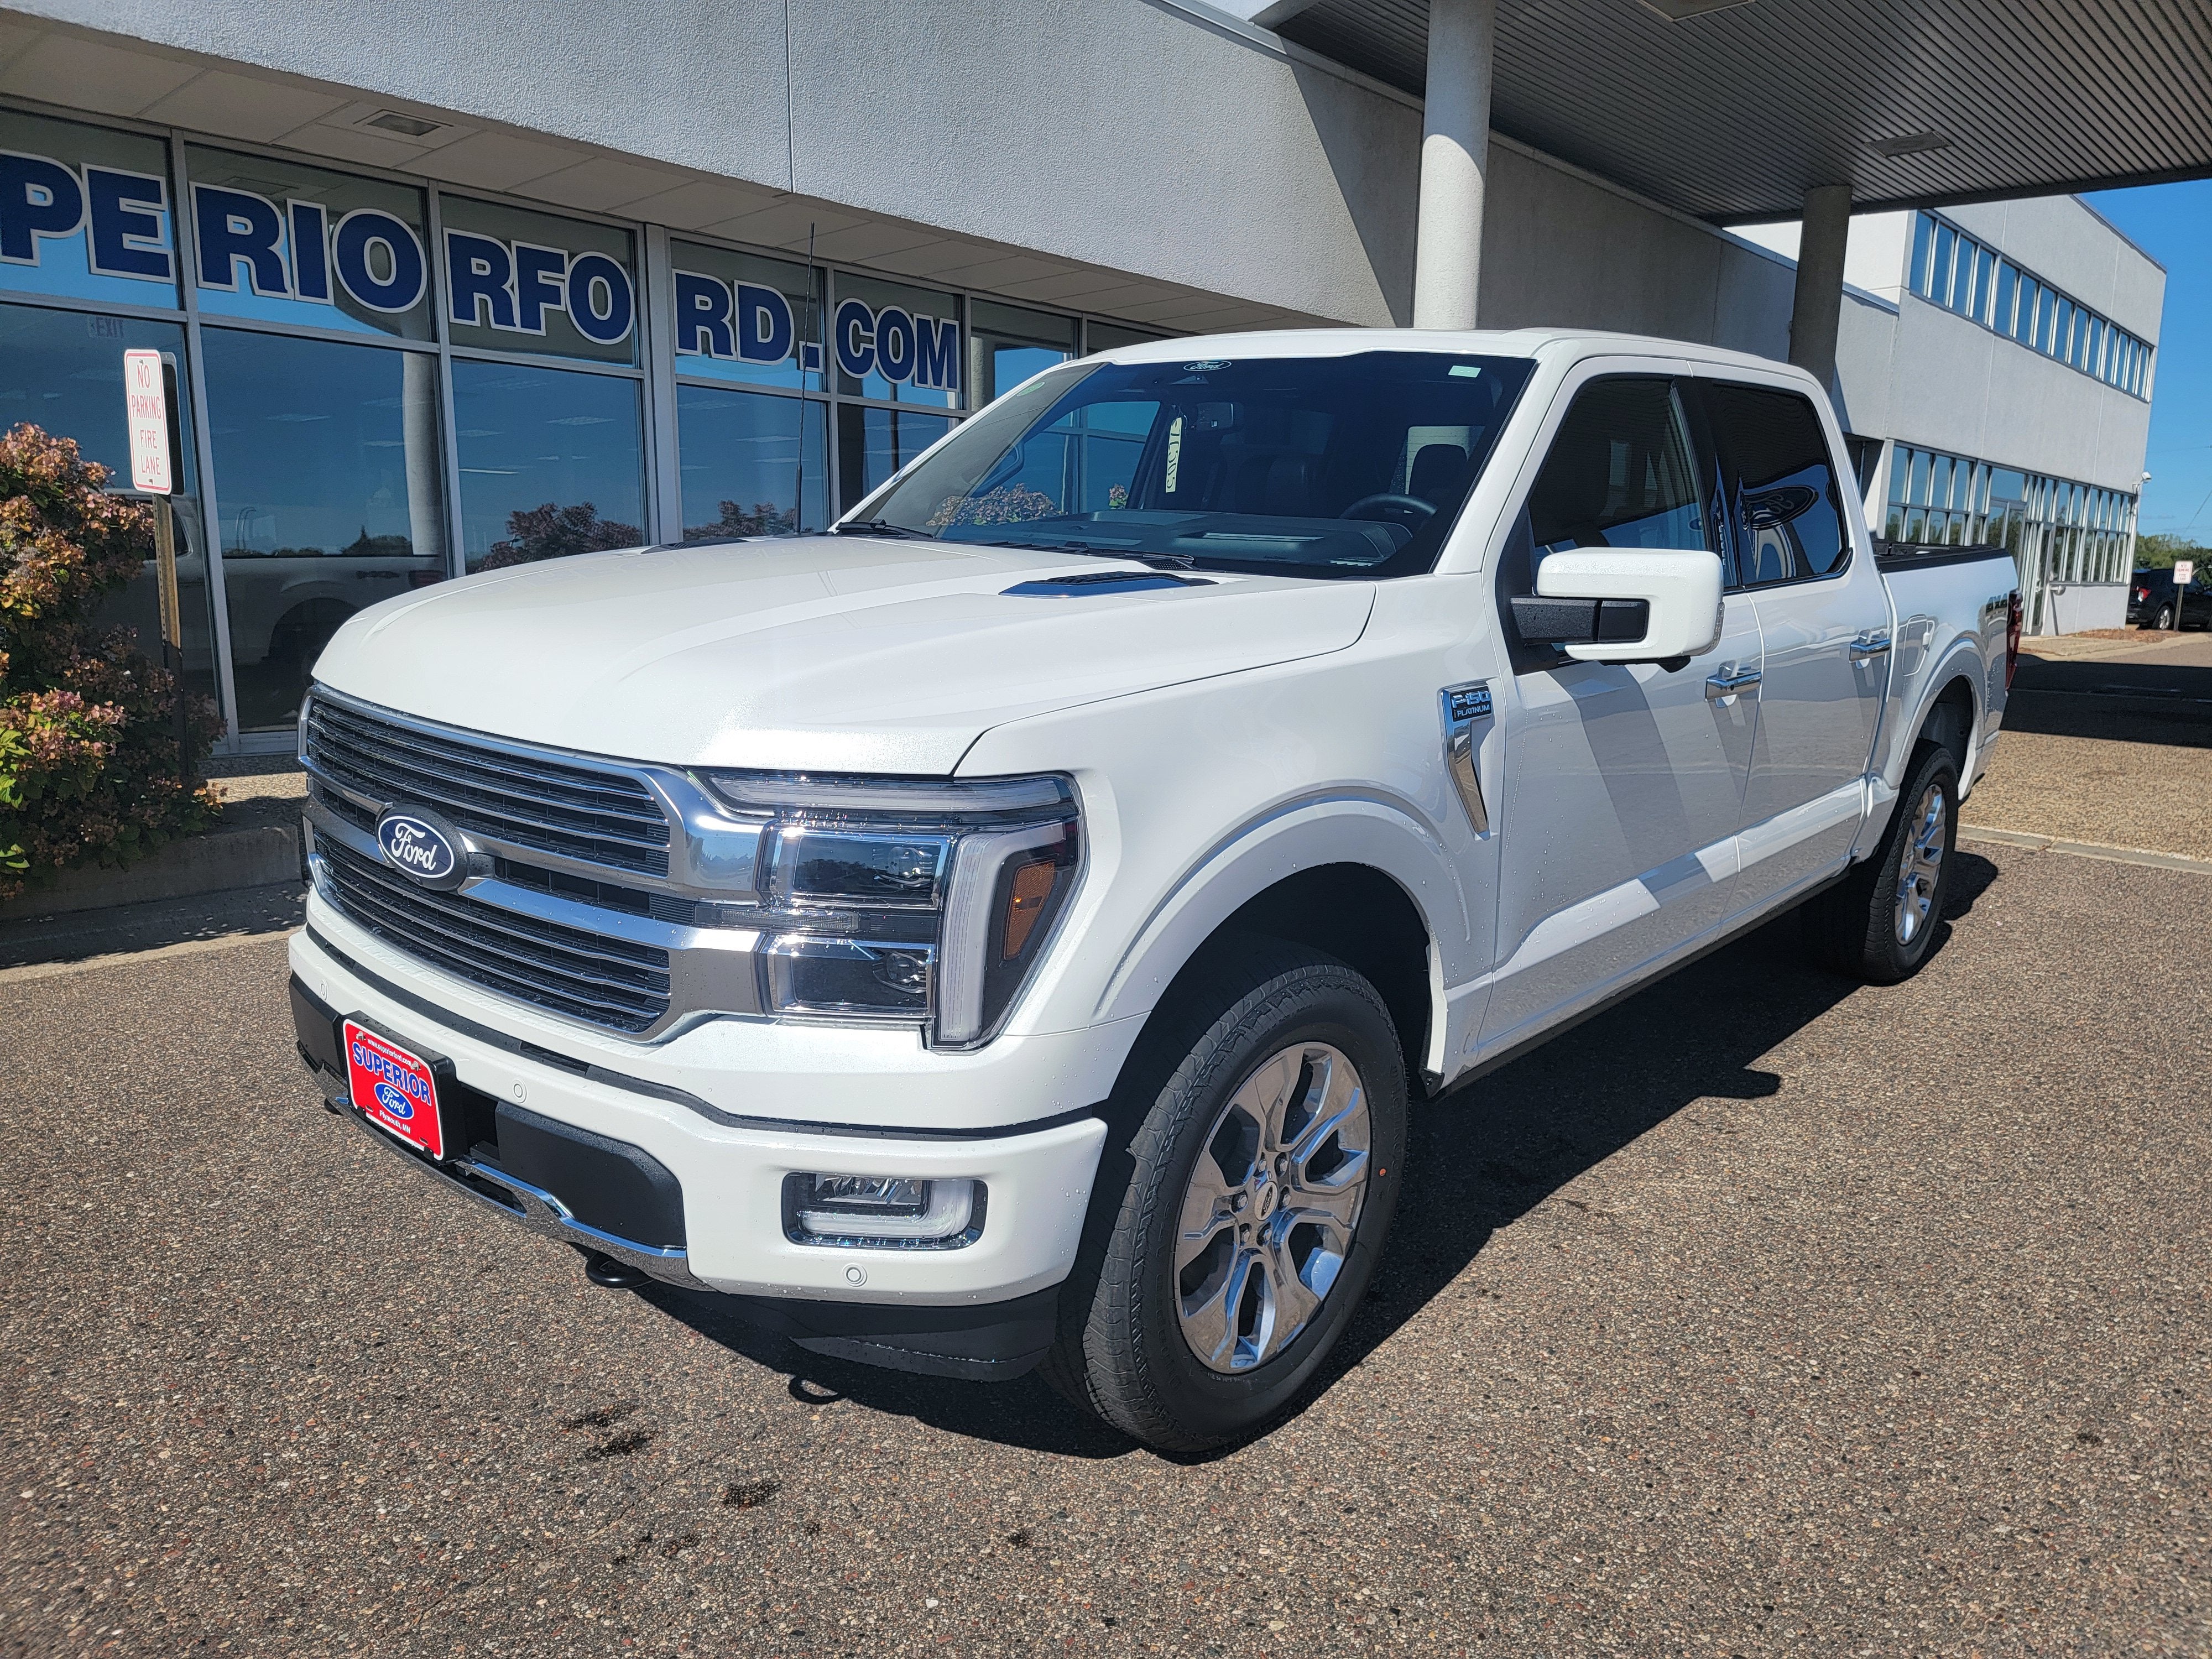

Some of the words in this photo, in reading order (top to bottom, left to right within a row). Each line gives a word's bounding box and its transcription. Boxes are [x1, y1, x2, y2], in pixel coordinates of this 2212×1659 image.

[137, 364, 150, 389] NO
[1190, 362, 1225, 370] Ford
[131, 394, 161, 420] PARKING
[140, 430, 158, 450] FIRE
[140, 455, 161, 476] LANE
[1451, 690, 1490, 708] F-150
[1457, 704, 1490, 717] PLATINUM
[391, 822, 439, 871] Ford
[367, 1039, 411, 1067] www.superiorford.com
[352, 1041, 432, 1107] SUPERIOR
[382, 1087, 406, 1115] Ford
[379, 1109, 402, 1130] Plymouth,
[402, 1123, 411, 1134] MN
